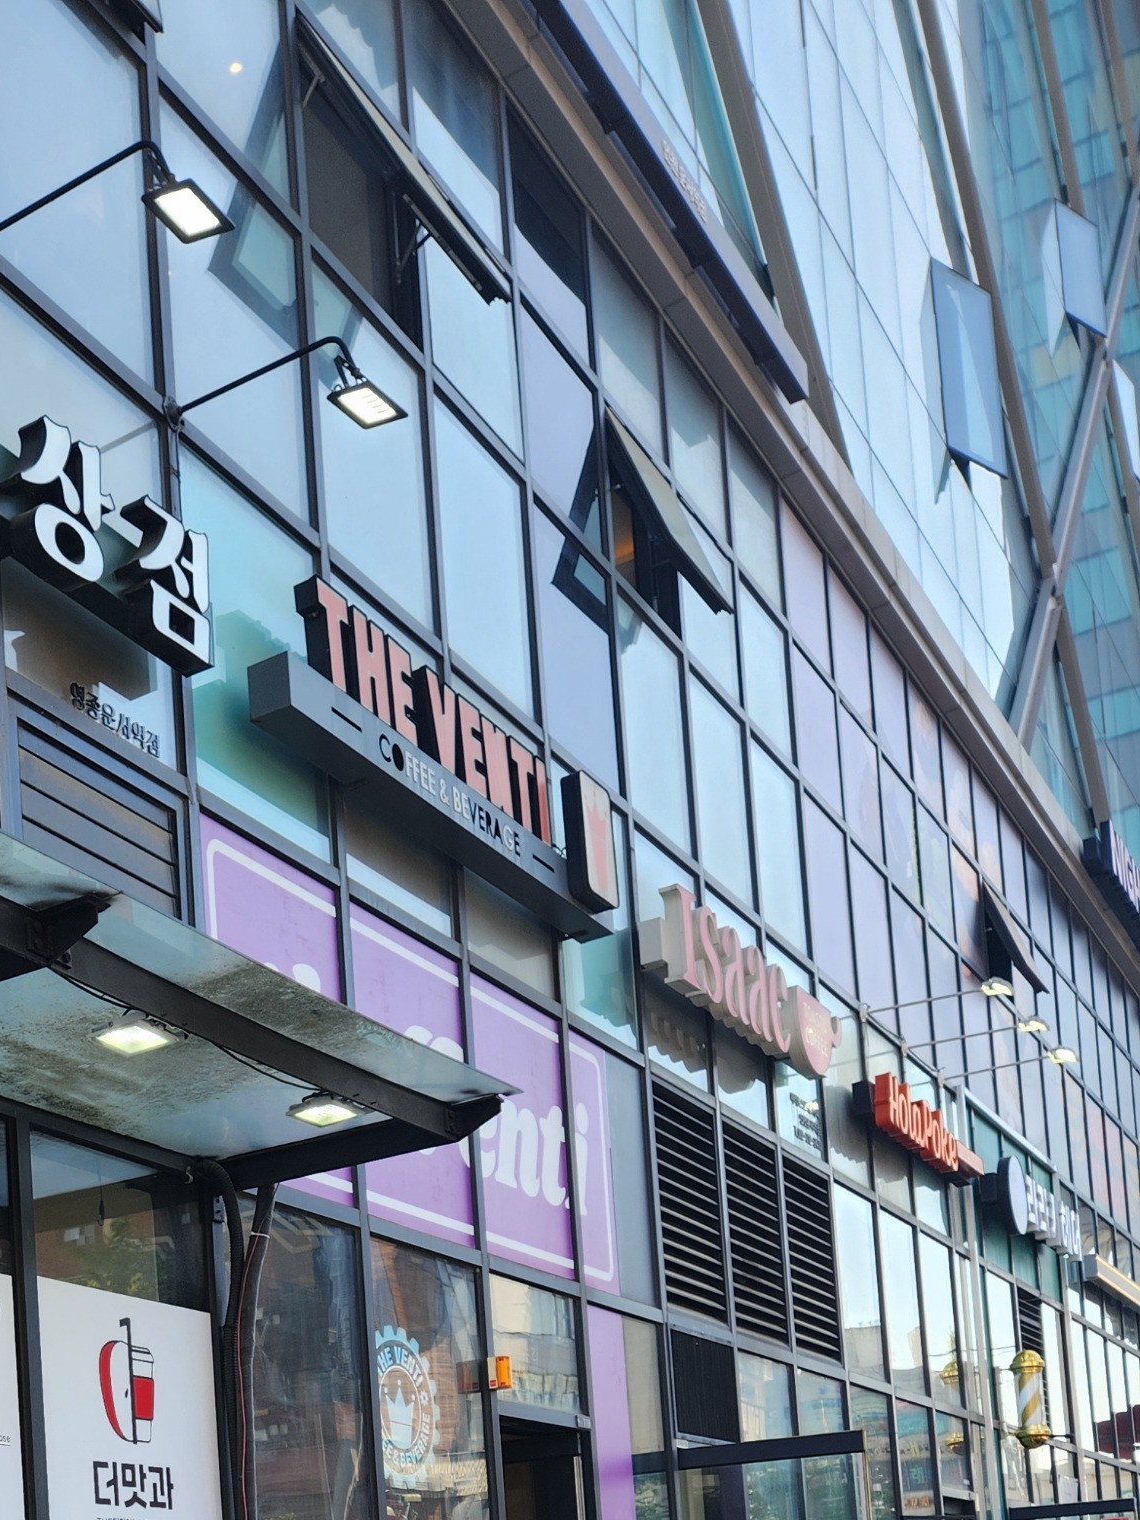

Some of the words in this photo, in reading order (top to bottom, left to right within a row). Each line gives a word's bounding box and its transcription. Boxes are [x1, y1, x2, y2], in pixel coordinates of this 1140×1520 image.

[70, 682, 160, 759] 영종운서역점
[313, 576, 419, 748] THE
[424, 666, 553, 846] VENTI
[379, 734, 437, 798] COFFEE
[438, 777, 451, 807] &
[451, 788, 521, 858] BEVERAGE
[659, 884, 792, 1053] Isaac
[394, 1345, 424, 1388] VENTI
[93, 1460, 175, 1511] 더맛과
